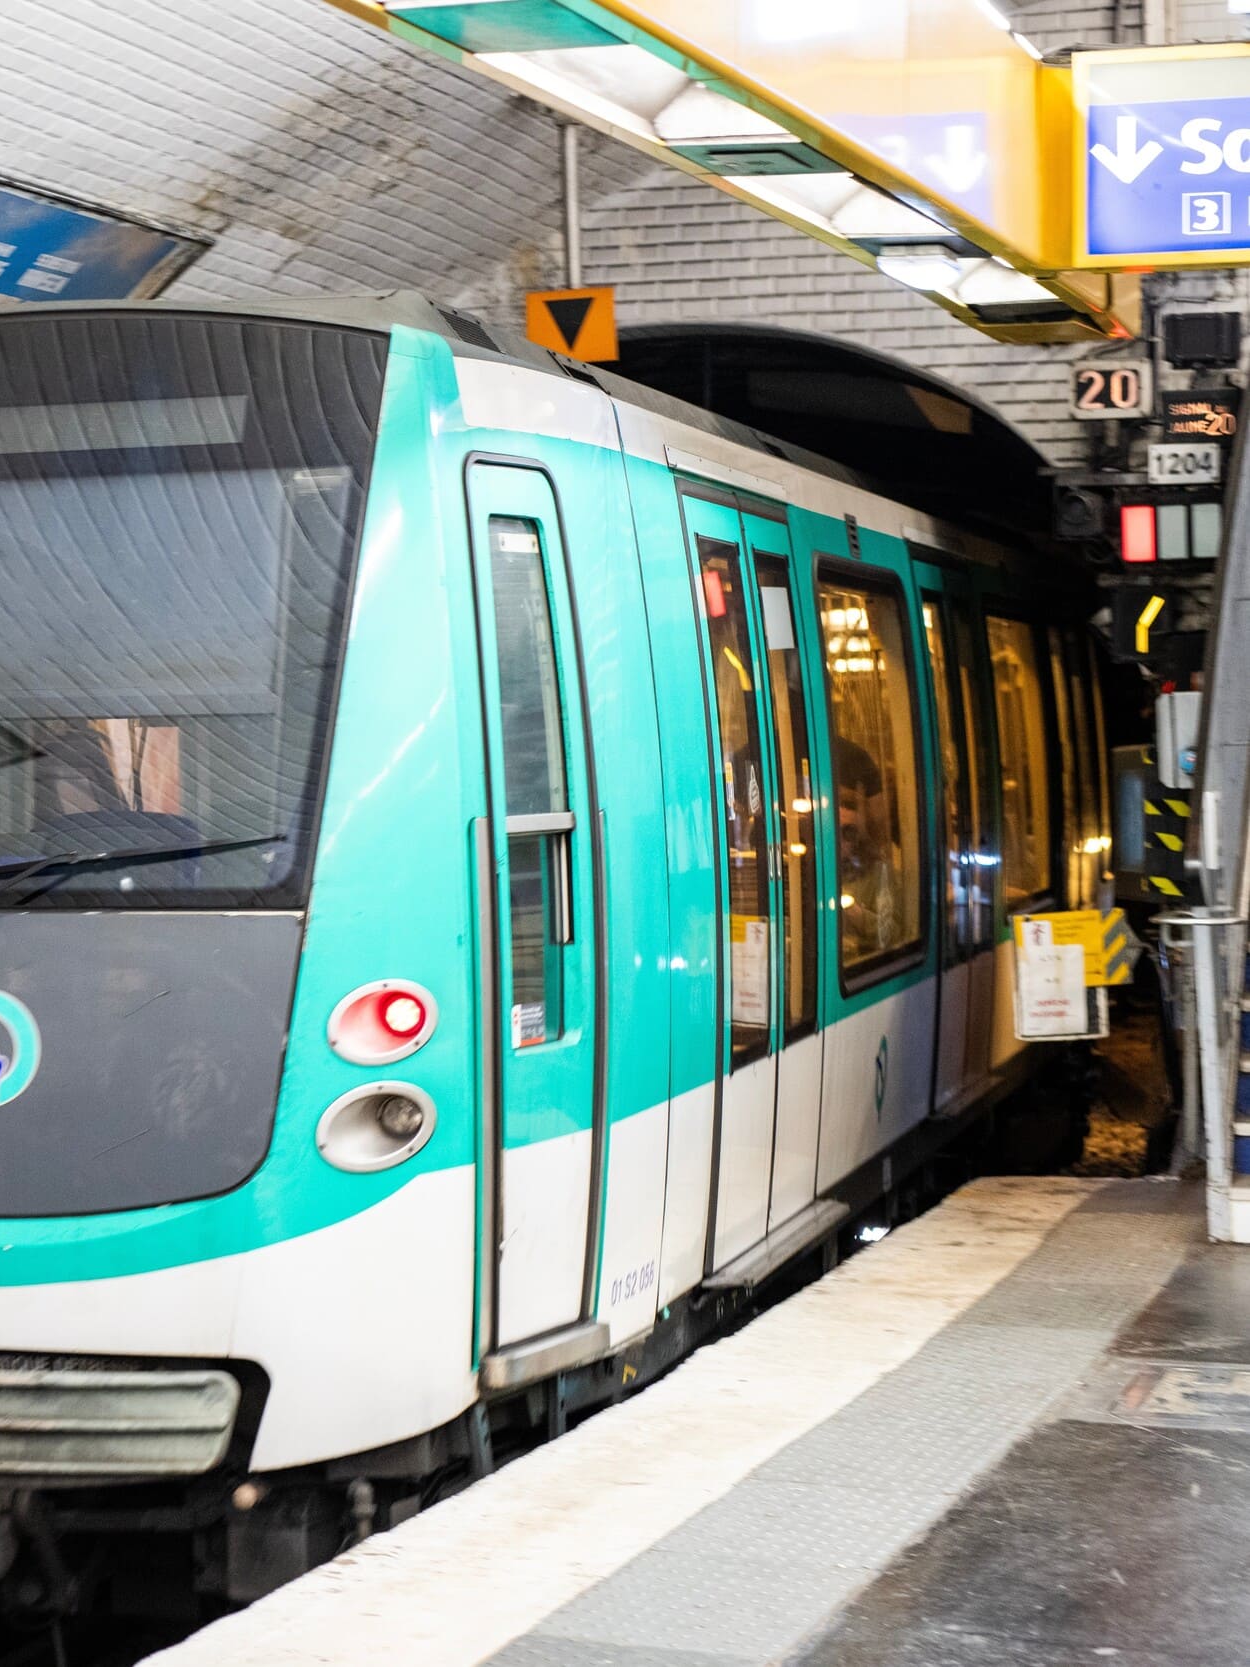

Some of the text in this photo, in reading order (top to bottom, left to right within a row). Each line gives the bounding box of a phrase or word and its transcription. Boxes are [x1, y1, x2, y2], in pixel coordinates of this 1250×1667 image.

[1192, 198, 1220, 231] 3
[1078, 369, 1139, 410] 20
[1155, 452, 1212, 475] 1204
